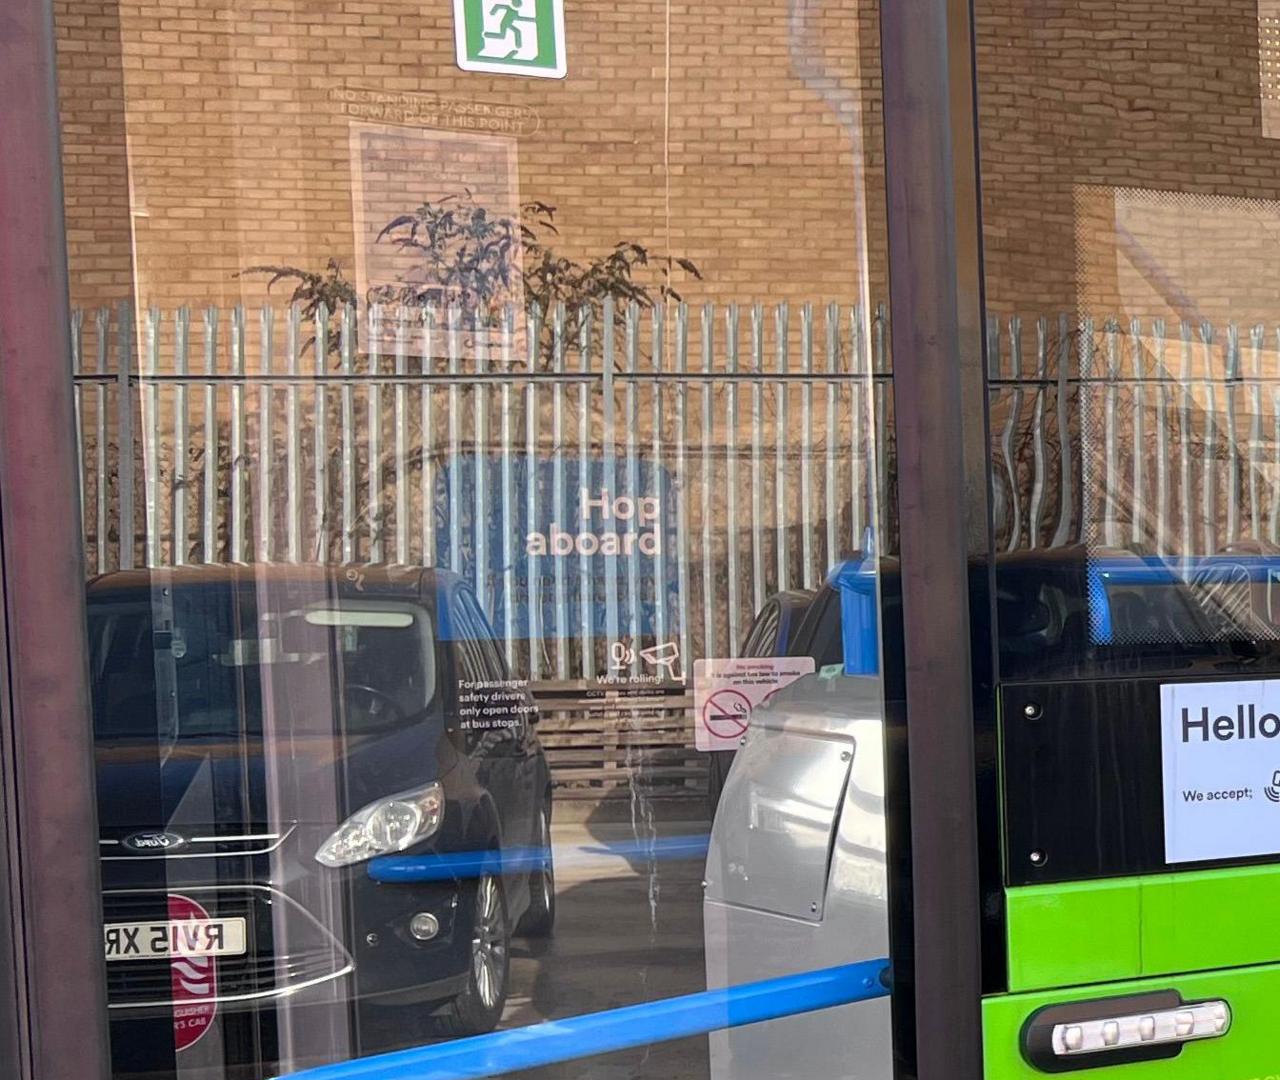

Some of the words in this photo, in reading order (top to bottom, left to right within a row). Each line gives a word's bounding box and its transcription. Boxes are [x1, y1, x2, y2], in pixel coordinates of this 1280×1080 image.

[340, 102, 414, 122] FORWARD
[417, 113, 438, 124] OF
[445, 115, 475, 128] THIS
[478, 118, 524, 132] POINT
[581, 487, 660, 526] Hop
[526, 522, 661, 556] aboard
[458, 679, 474, 689] For
[475, 678, 528, 691] passenger
[597, 675, 627, 685] We're
[459, 693, 489, 704] safety
[491, 692, 526, 702] drivers
[459, 706, 480, 718] only
[482, 706, 508, 717] open
[510, 704, 539, 714] doors
[460, 720, 470, 729] at
[472, 719, 490, 729] bus
[1182, 703, 1280, 743] Hello
[1182, 790, 1204, 802] We
